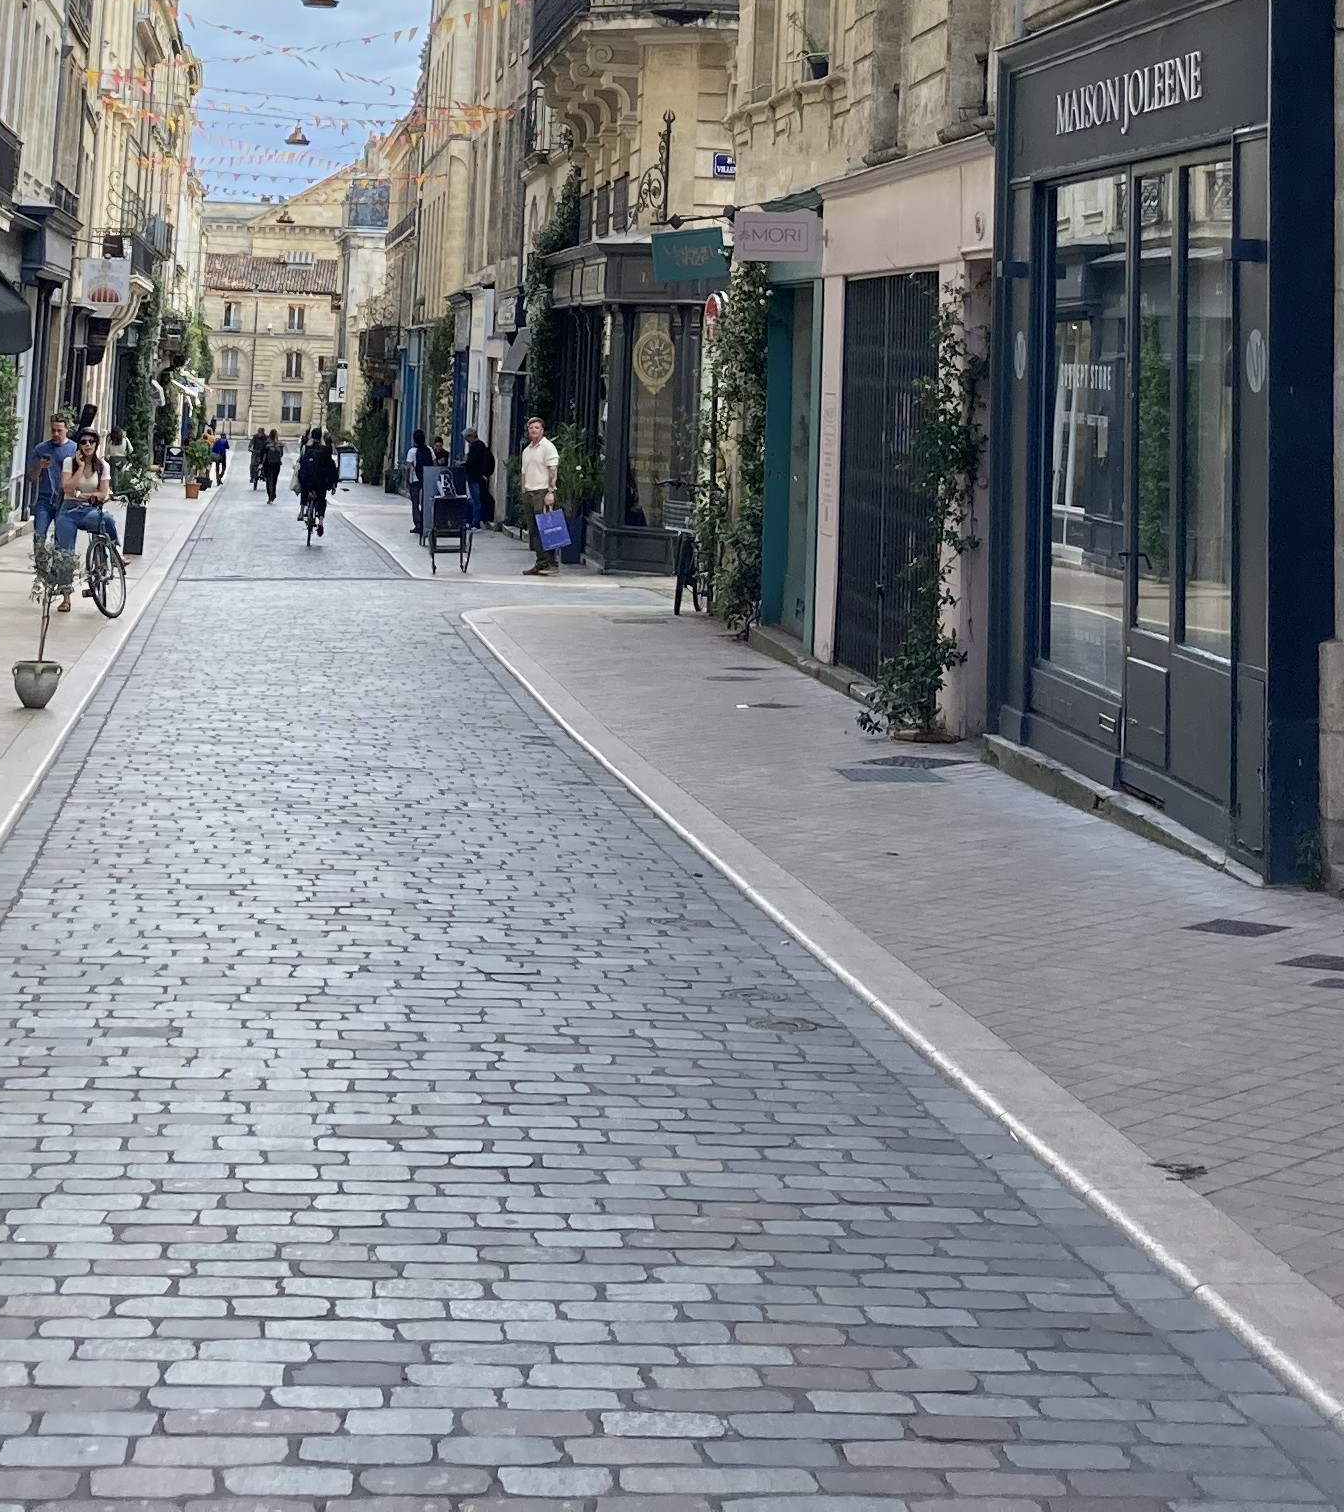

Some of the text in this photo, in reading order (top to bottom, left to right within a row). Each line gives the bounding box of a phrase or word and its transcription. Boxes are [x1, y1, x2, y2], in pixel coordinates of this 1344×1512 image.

[1055, 50, 1203, 135] MAISON JOLEENE
[752, 227, 801, 243] MORI
[1090, 364, 1112, 391] STORE
